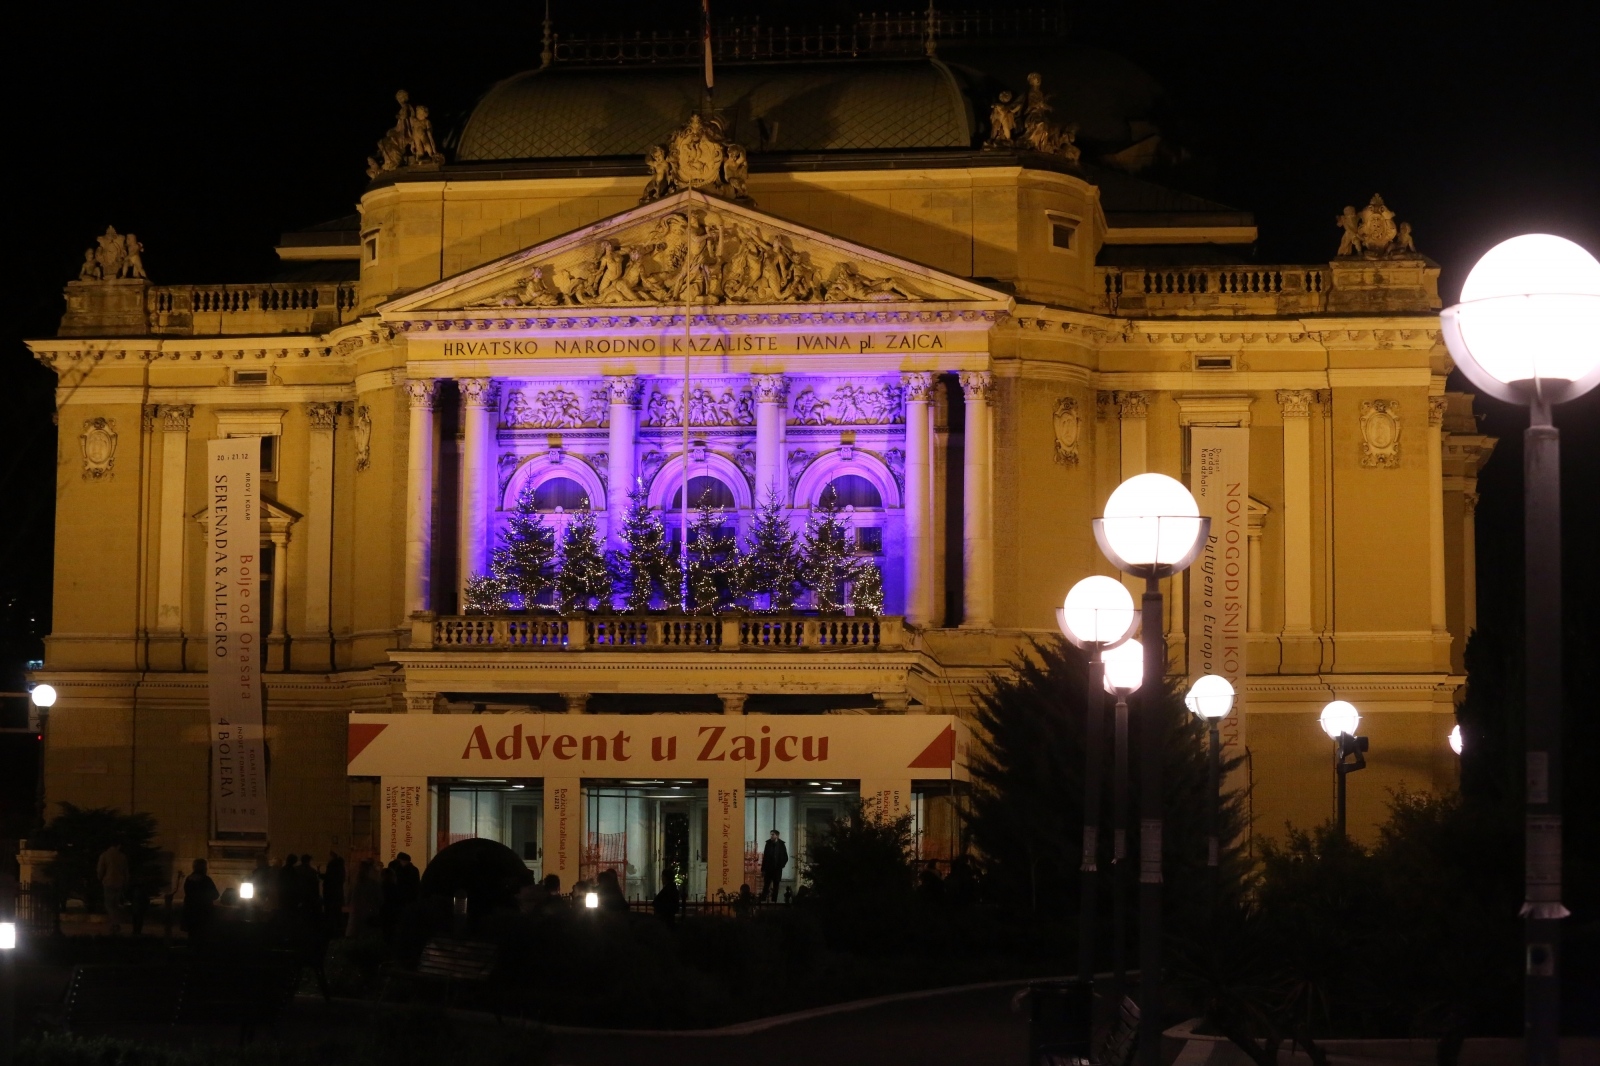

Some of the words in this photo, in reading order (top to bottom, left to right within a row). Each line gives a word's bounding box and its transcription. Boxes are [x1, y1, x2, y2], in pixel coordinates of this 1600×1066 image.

[443, 340, 538, 356] HRVATSKO
[554, 338, 656, 354] NARODNO
[672, 334, 777, 352] KAZALIŠTE
[796, 335, 851, 350] IVANA
[885, 334, 943, 349] ZAJCA
[1200, 448, 1208, 497] Kamdzhalov
[1208, 448, 1216, 475] Yordan
[214, 475, 228, 563] SERENADA
[214, 566, 228, 577] &
[236, 555, 254, 597] Bolje
[1200, 535, 1218, 608] Putujemo
[1221, 482, 1242, 639] NOVOGODIŠNJI
[214, 581, 228, 658] ALLEGRO
[239, 603, 254, 624] od
[218, 717, 231, 726] 4
[218, 731, 235, 798] BOLERA
[461, 723, 632, 761] Advent
[651, 735, 677, 761] u
[696, 725, 829, 772] Zajcu
